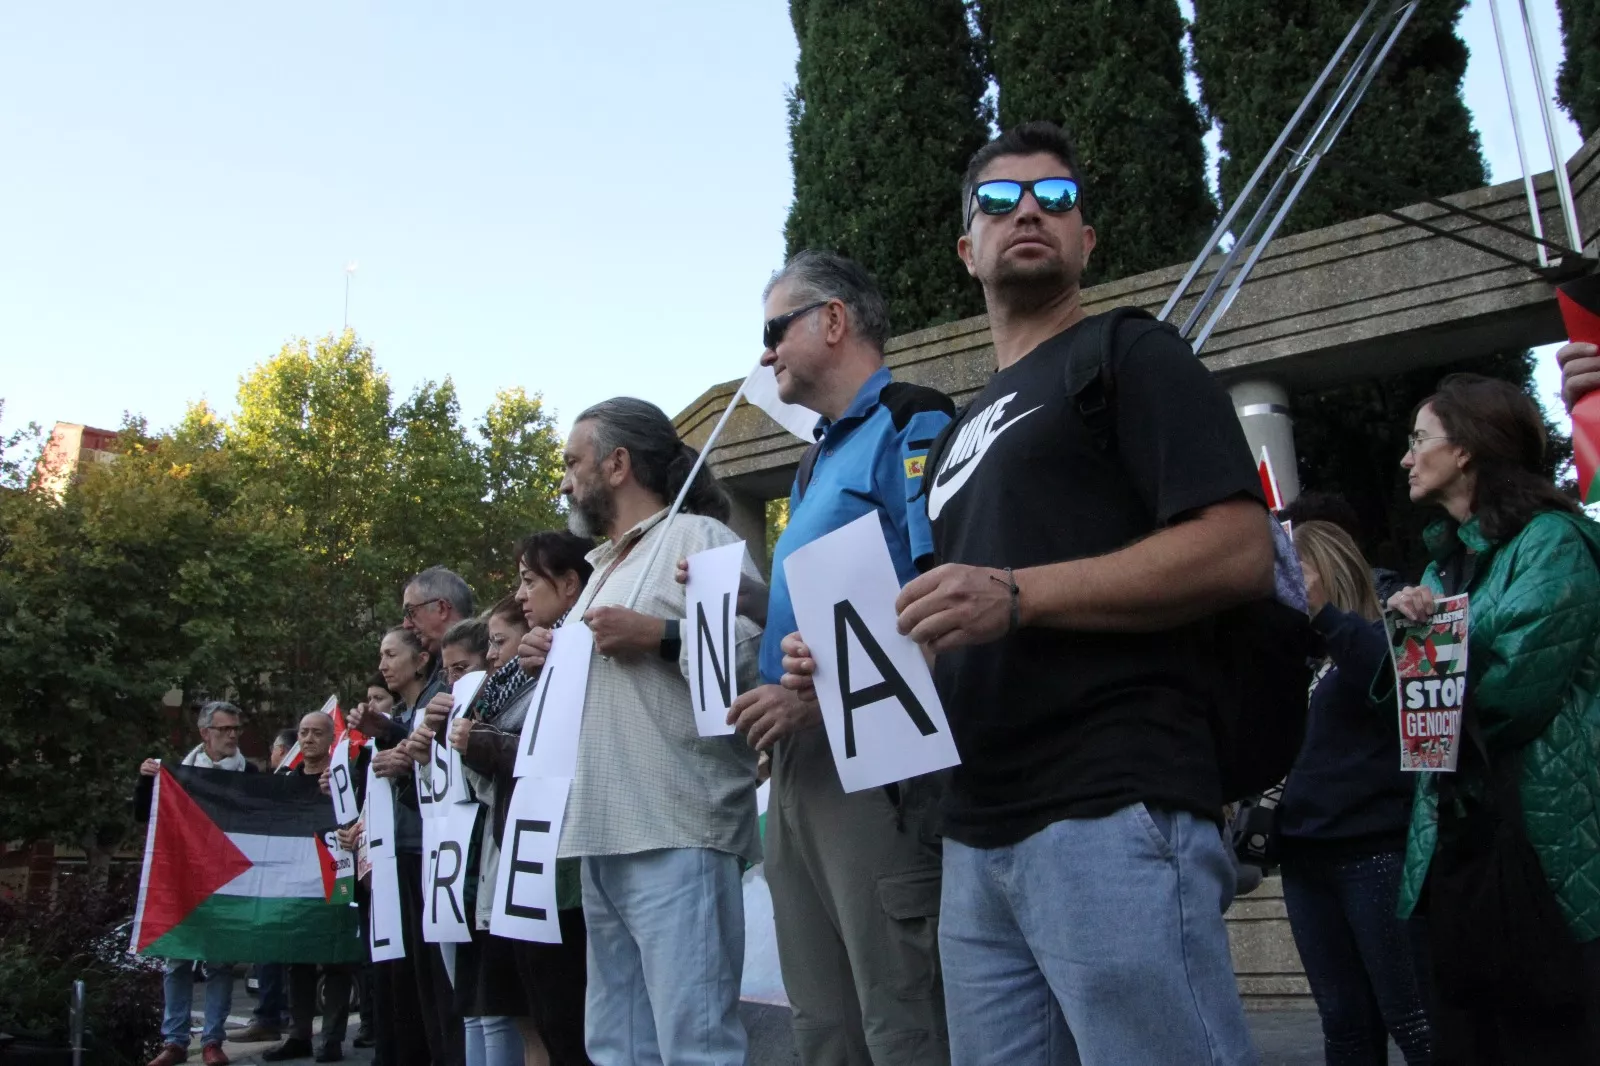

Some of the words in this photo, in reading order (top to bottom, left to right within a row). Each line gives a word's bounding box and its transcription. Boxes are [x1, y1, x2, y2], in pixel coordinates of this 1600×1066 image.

[939, 391, 1019, 475] NIKE
[697, 592, 731, 711] N
[833, 599, 939, 759] A
[333, 764, 348, 813] P
[432, 841, 465, 924] R
[505, 819, 551, 920] E
